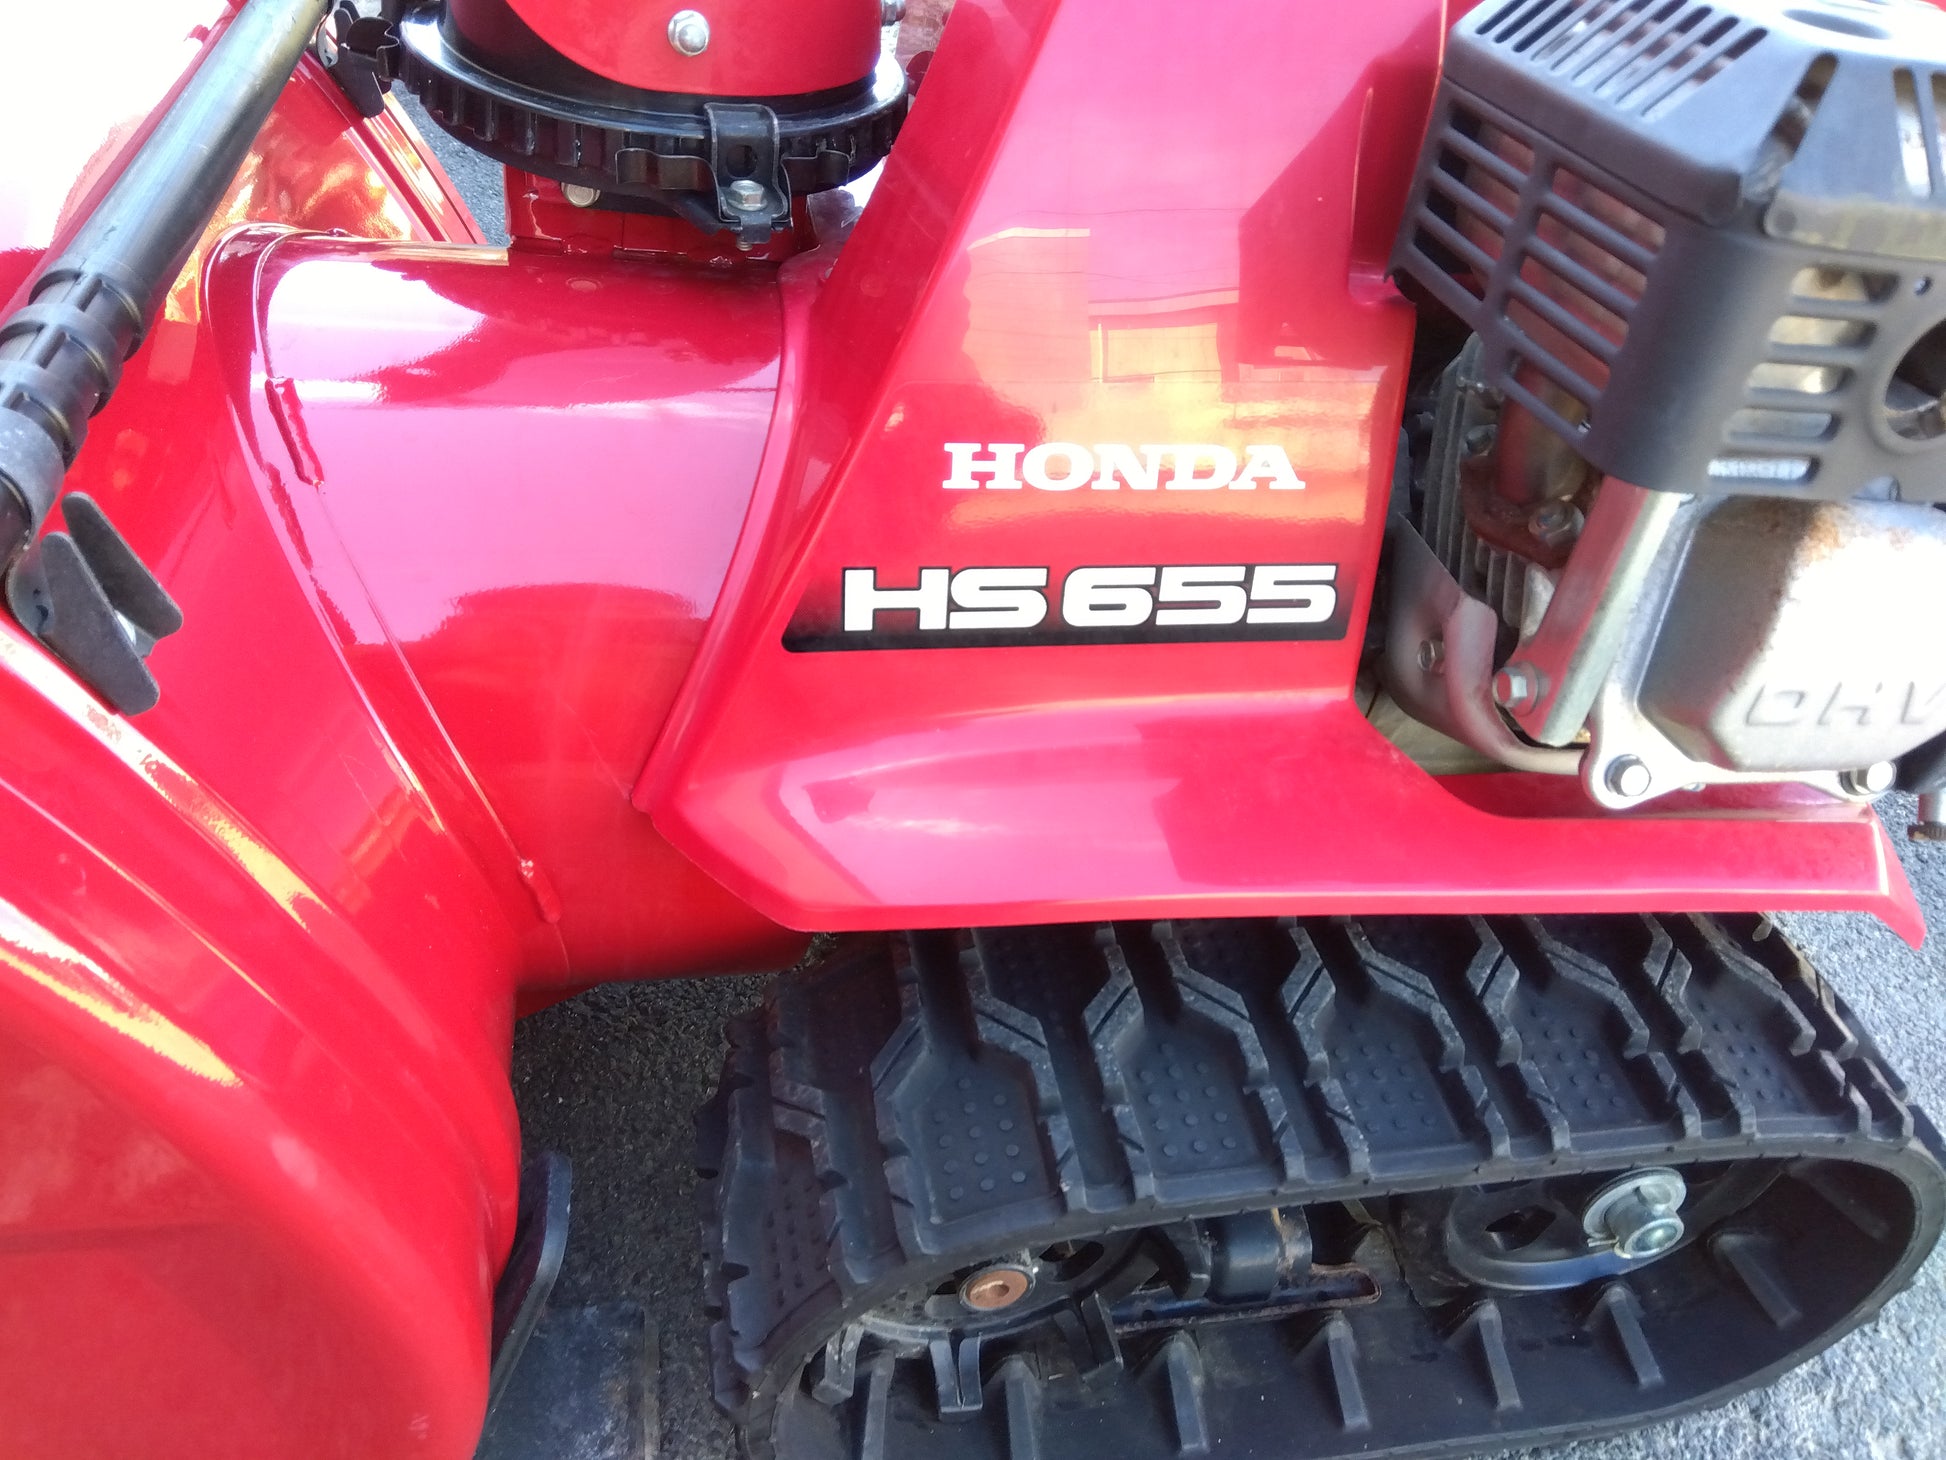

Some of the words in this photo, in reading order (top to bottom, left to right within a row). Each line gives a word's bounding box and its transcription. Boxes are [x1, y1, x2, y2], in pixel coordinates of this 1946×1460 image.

[942, 442, 1306, 491] HONDA
[842, 567, 1049, 632] HS
[1062, 565, 1337, 628] 655
